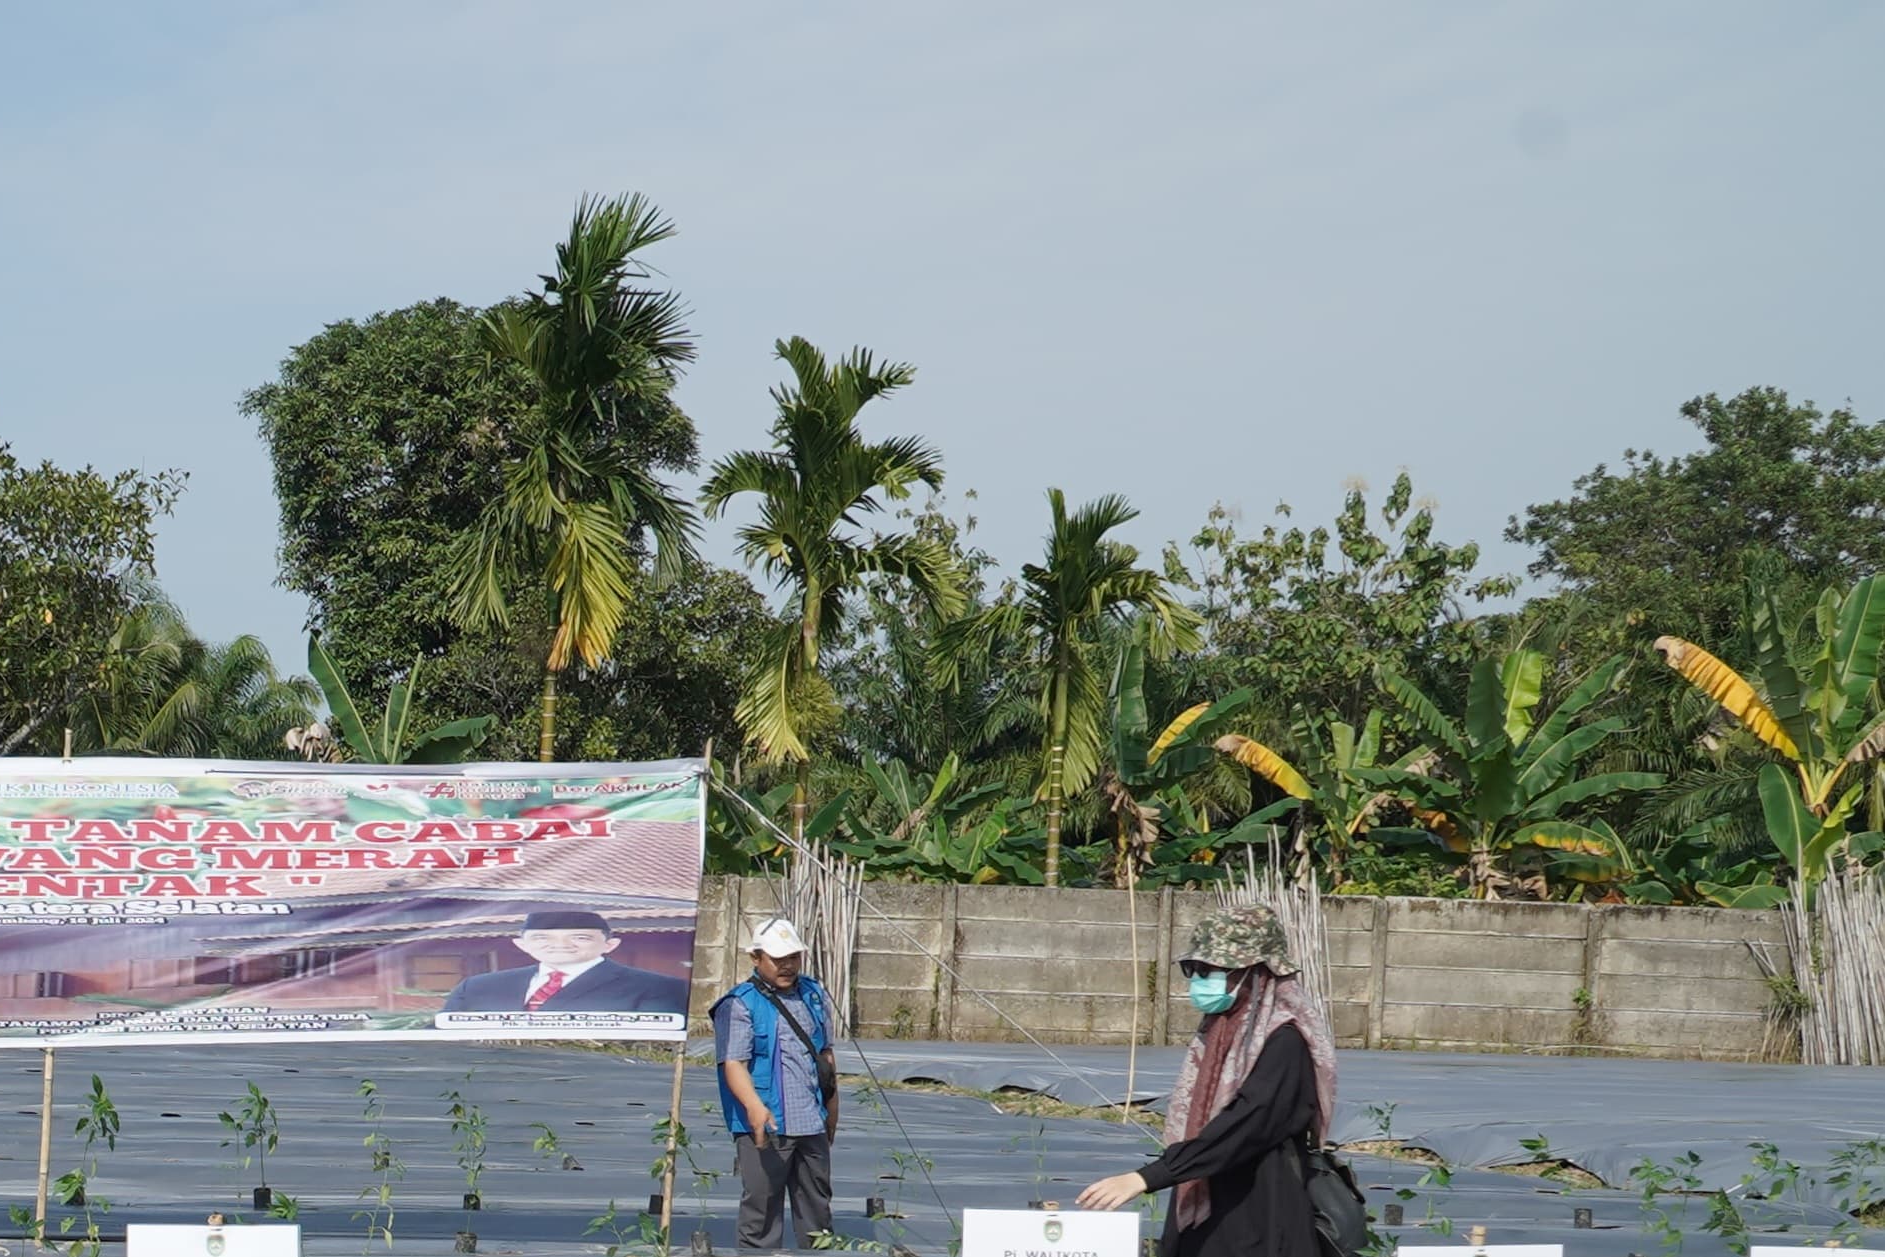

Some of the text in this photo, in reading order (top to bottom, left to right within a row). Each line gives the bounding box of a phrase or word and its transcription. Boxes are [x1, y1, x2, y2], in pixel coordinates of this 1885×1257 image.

[31, 782, 177, 793] INDONESIA
[11, 820, 337, 843] TANAM
[355, 819, 612, 844] CABAI
[215, 847, 521, 870] MERAH
[121, 899, 293, 916] Selatan
[160, 1007, 270, 1018] PERTANIAN
[182, 1015, 227, 1024] DAN
[37, 1026, 125, 1035] PROVINSI
[237, 1021, 329, 1031] SELATAN
